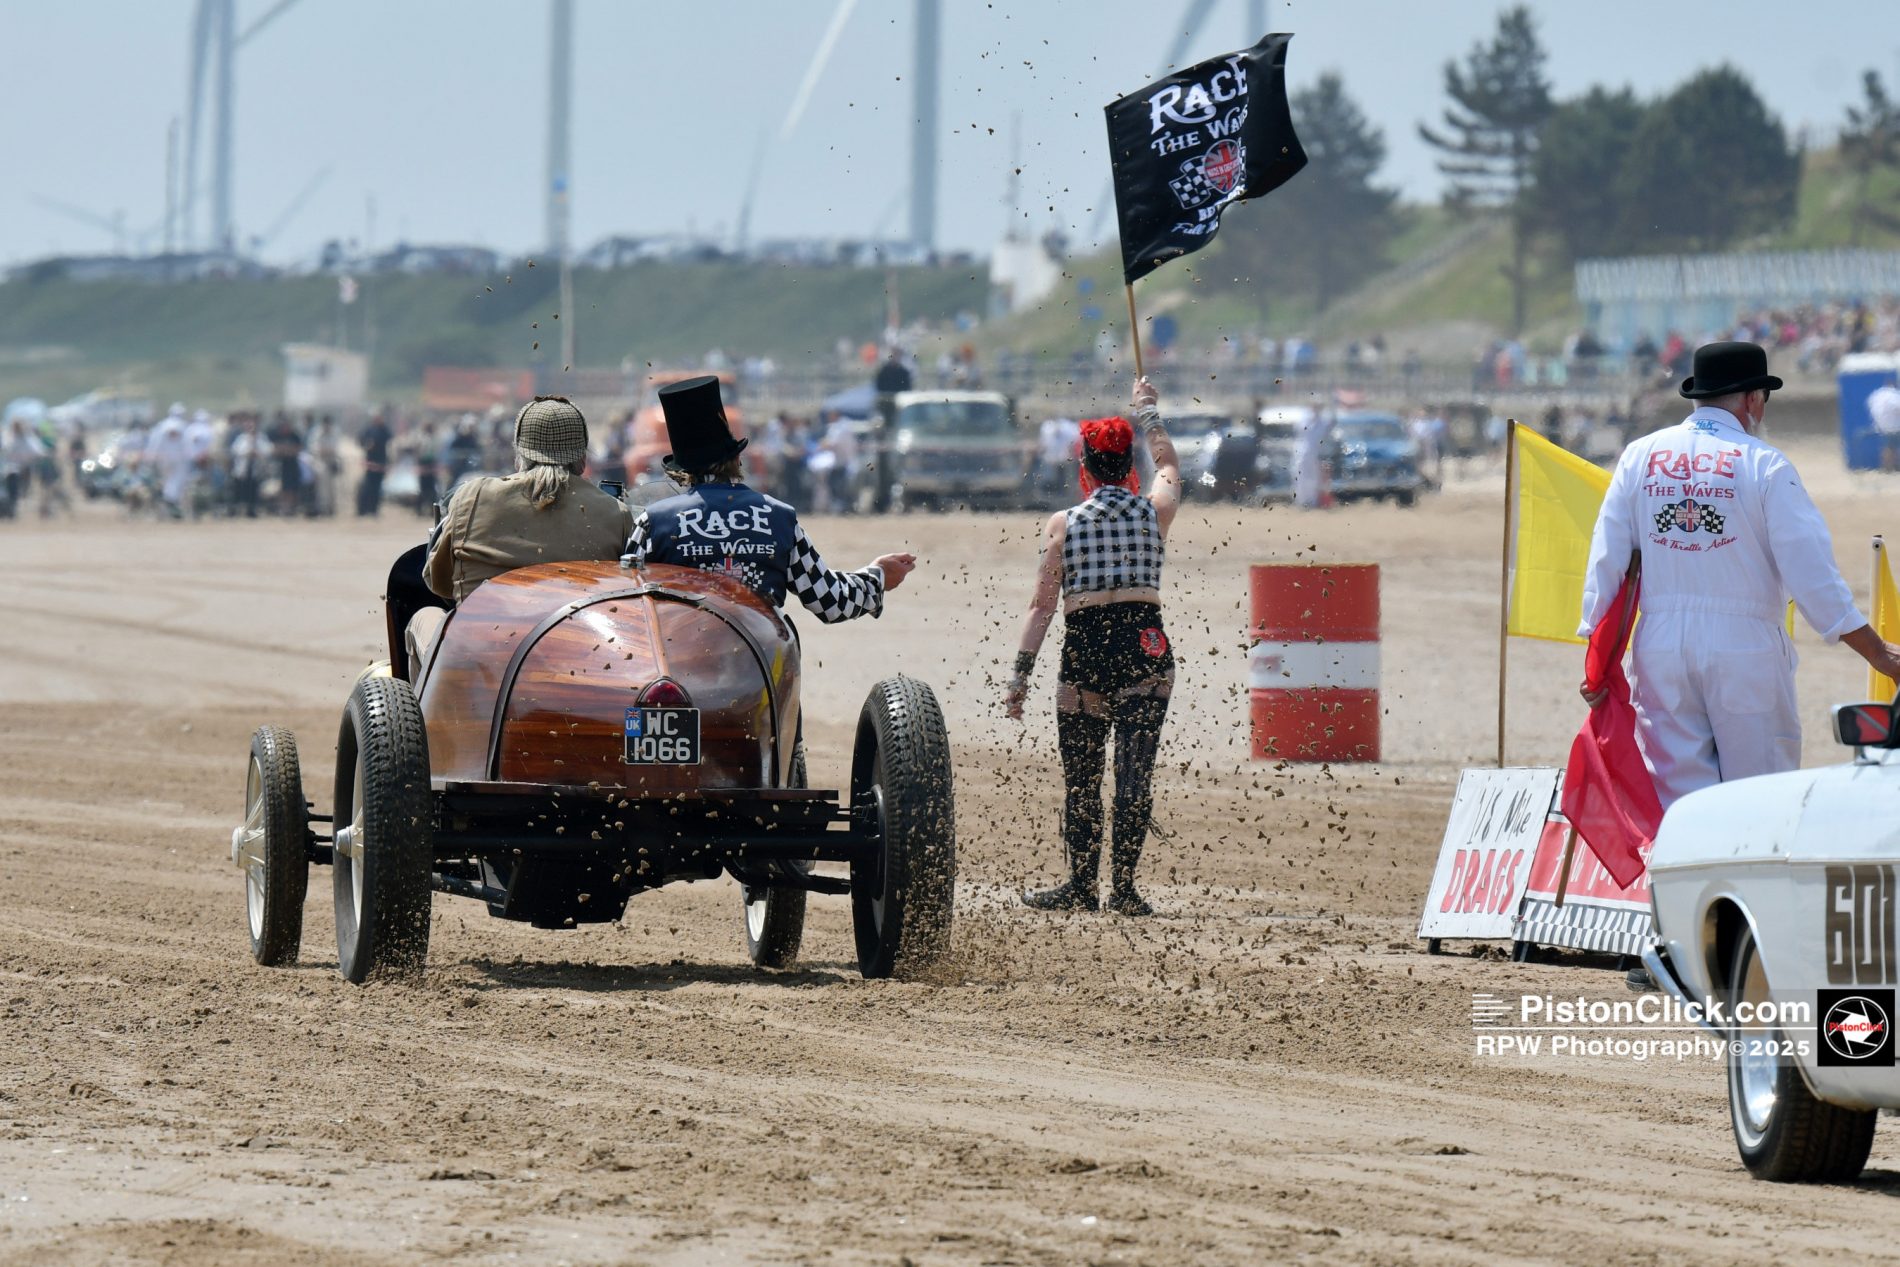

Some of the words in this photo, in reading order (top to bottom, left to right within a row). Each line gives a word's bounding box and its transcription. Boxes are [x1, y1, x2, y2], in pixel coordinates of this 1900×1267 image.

[1149, 53, 1249, 135] RACE
[1150, 131, 1201, 157] THE
[1646, 449, 1742, 480] RACE
[1643, 482, 1676, 497] THE
[1682, 481, 1735, 499] WAVES
[676, 504, 773, 539] RACE
[676, 541, 714, 557] THE
[719, 538, 776, 557] WAVES
[1648, 532, 1668, 547] Full
[1669, 540, 1702, 552] Throttle
[1704, 536, 1738, 552] Action
[625, 719, 641, 731] UK
[646, 711, 679, 736] WC
[634, 737, 691, 761] 1066
[1494, 788, 1533, 843] Mile
[1440, 848, 1525, 915] DRAGS
